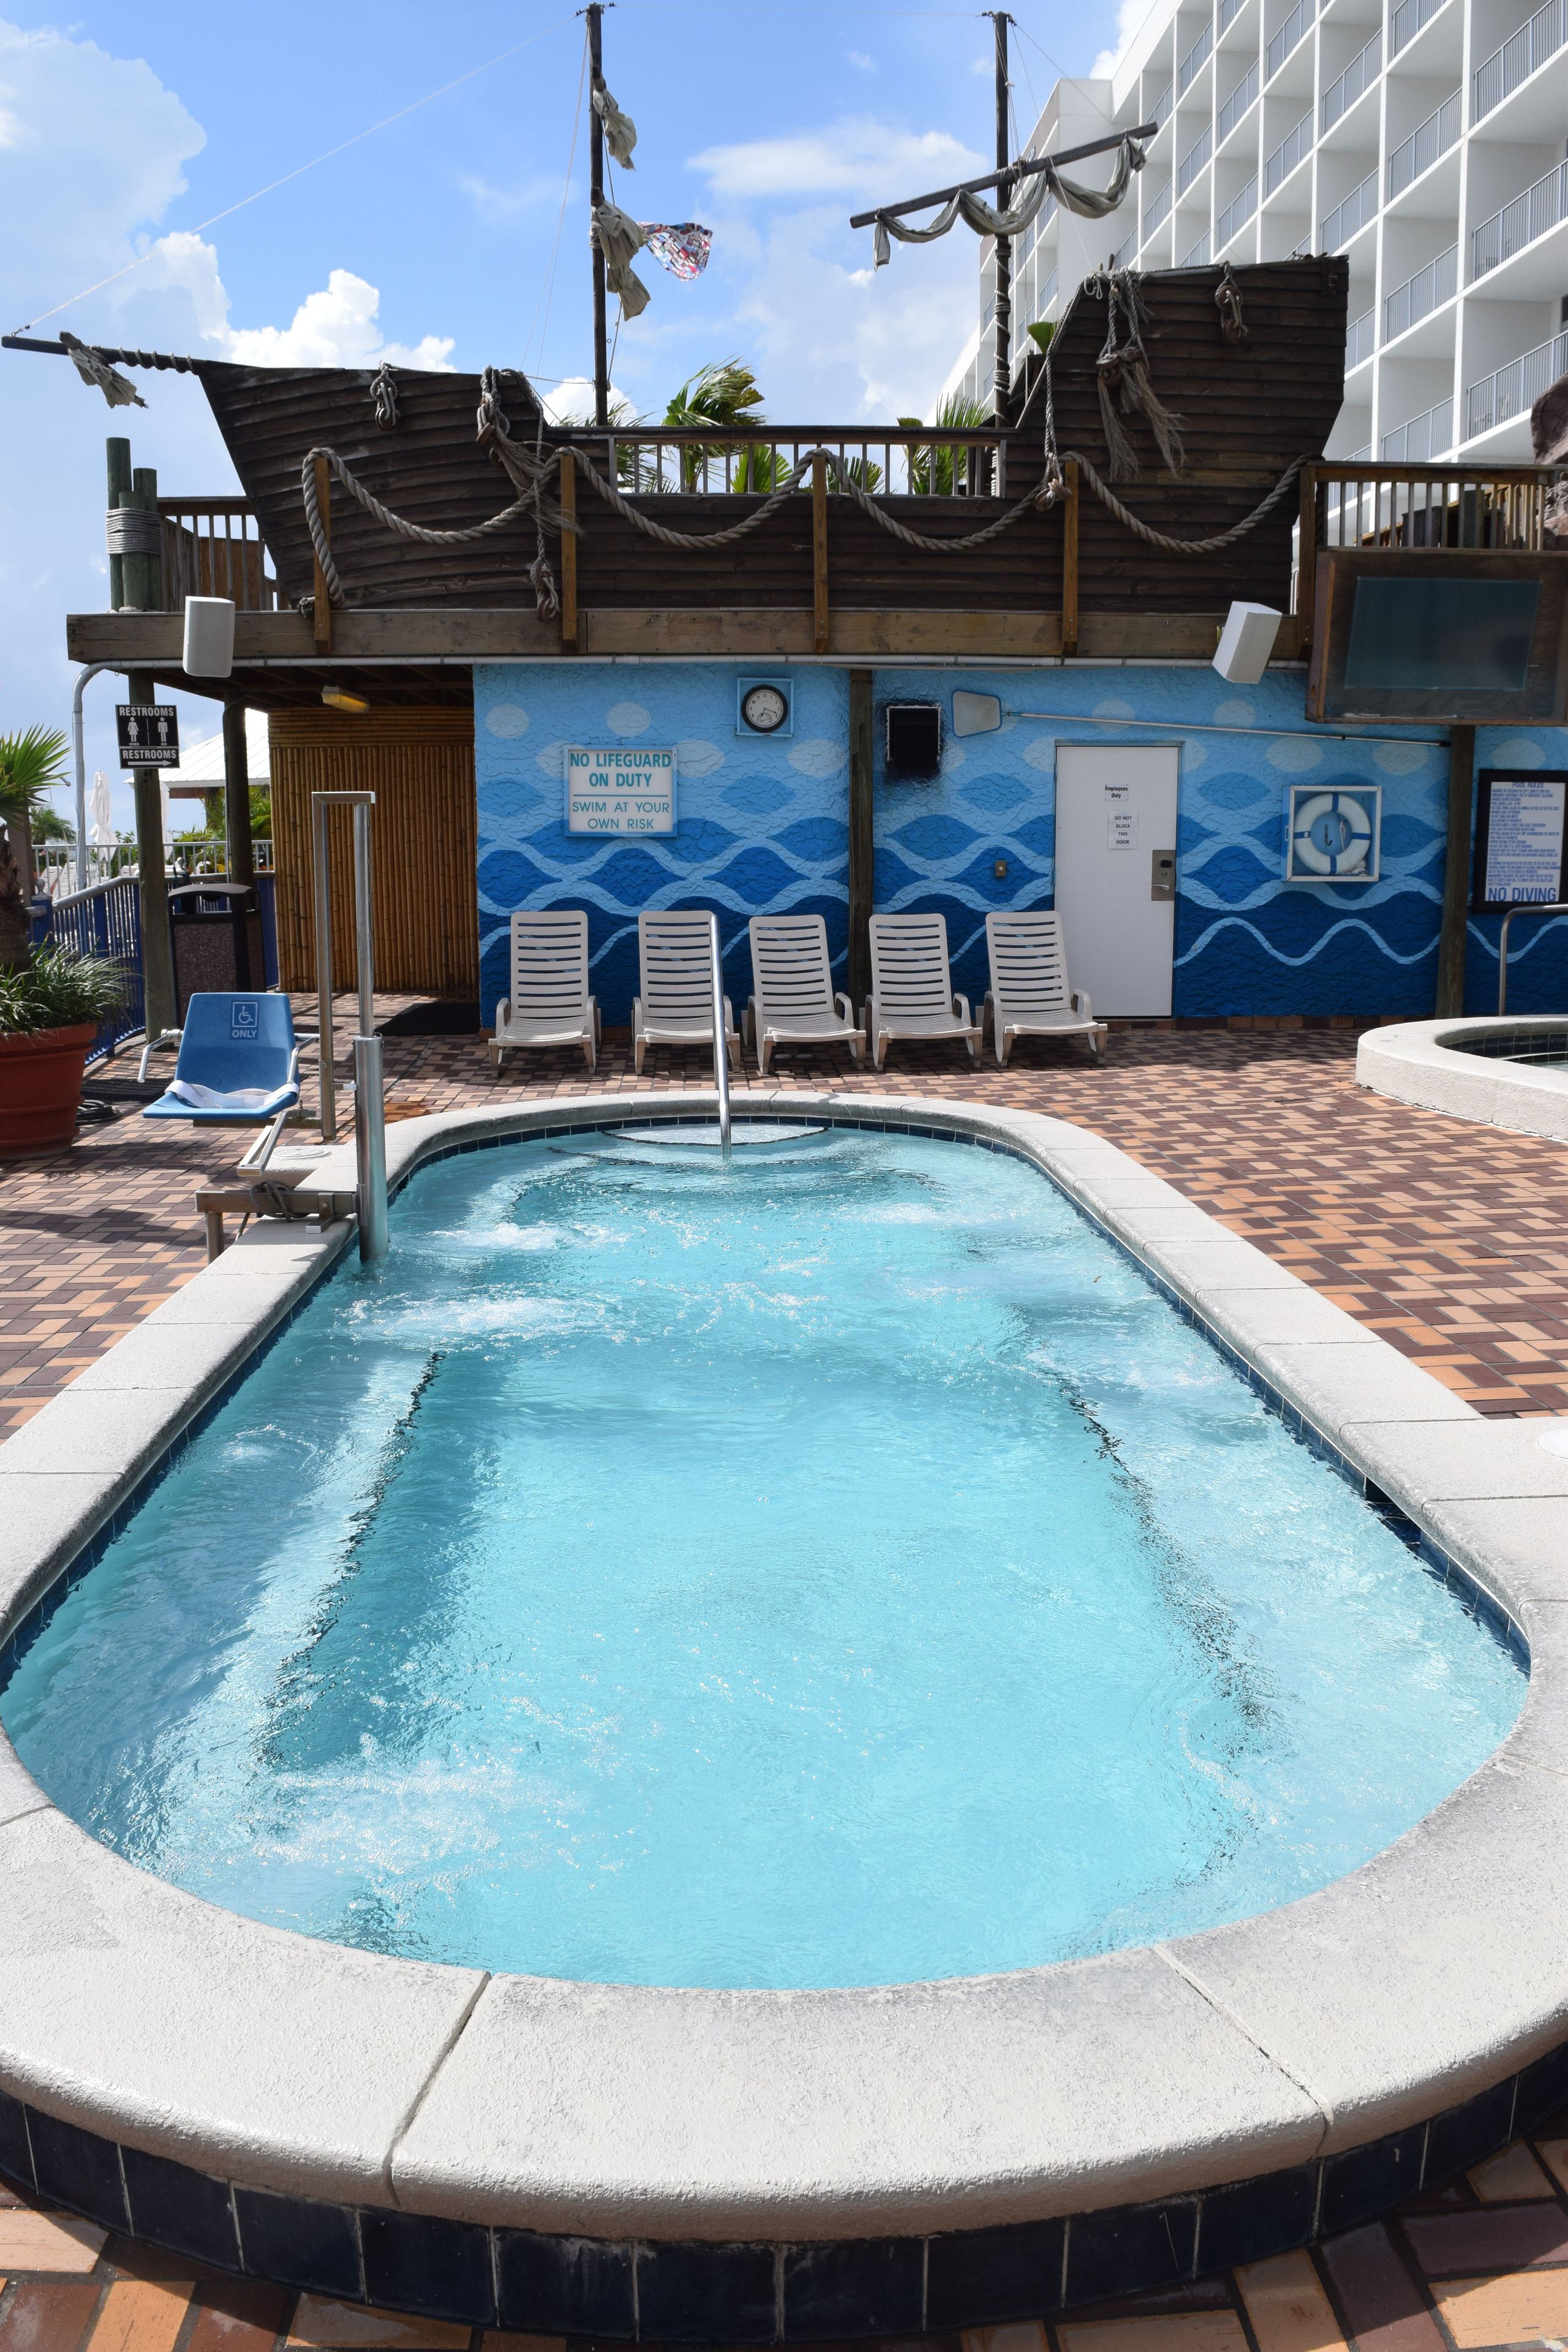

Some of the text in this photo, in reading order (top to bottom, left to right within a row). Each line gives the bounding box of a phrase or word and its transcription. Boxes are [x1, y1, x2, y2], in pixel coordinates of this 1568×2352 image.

[119, 707, 174, 716] RESTROOMS
[123, 750, 176, 759] RESTROOMS
[570, 753, 671, 768] NO LIFEGUARD
[589, 773, 652, 787] ON DUTY
[573, 802, 669, 813] SWIM AT YOUR
[587, 818, 654, 829] OWN RISK
[1488, 887, 1556, 902] NO DIVING
[232, 1030, 257, 1038] ONLY
